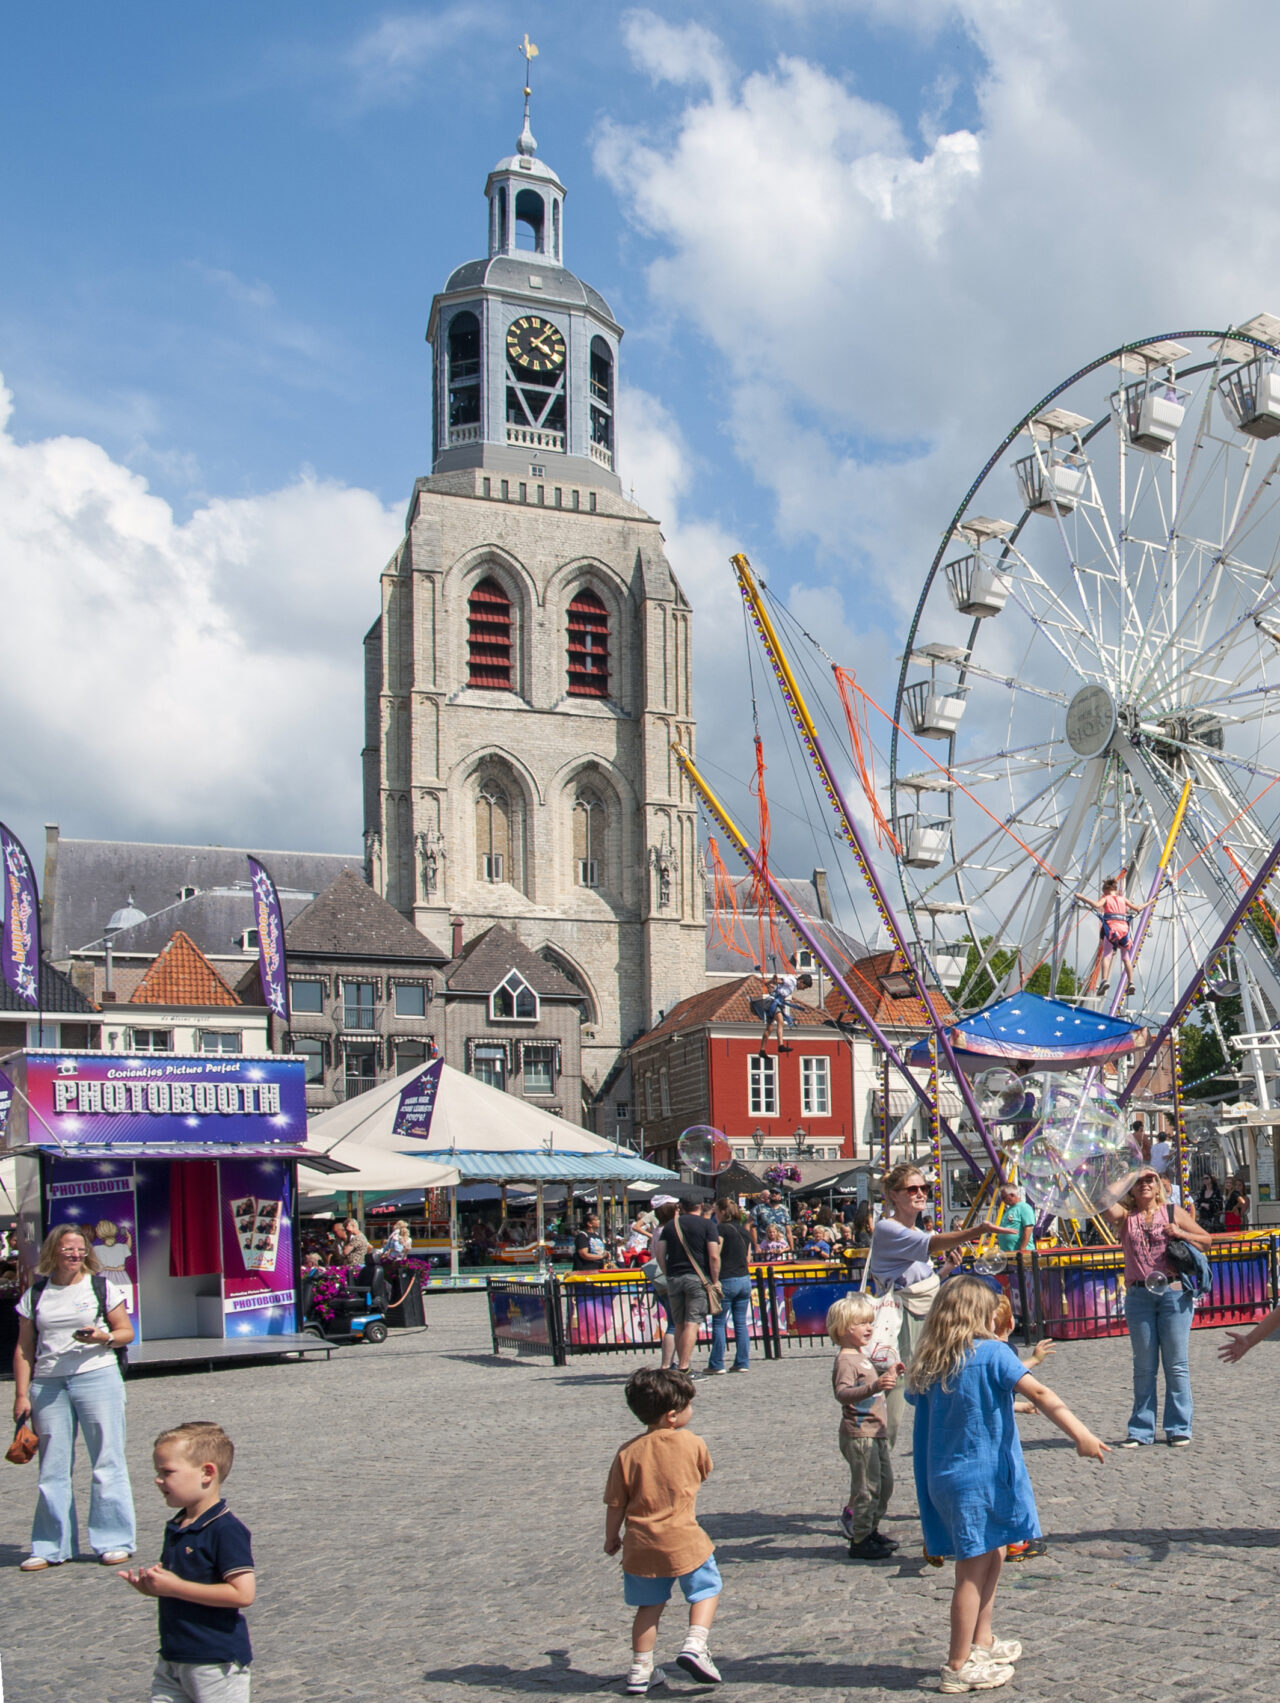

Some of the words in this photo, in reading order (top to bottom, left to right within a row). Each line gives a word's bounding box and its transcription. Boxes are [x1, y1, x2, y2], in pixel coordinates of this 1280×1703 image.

[166, 1064, 202, 1075] Picture
[205, 1062, 241, 1073] Perfect
[53, 1081, 281, 1114] PHOTOBOOTH
[52, 1179, 130, 1197] PHOTOBOOTH
[232, 1291, 293, 1310] PHOTOBOOTH
